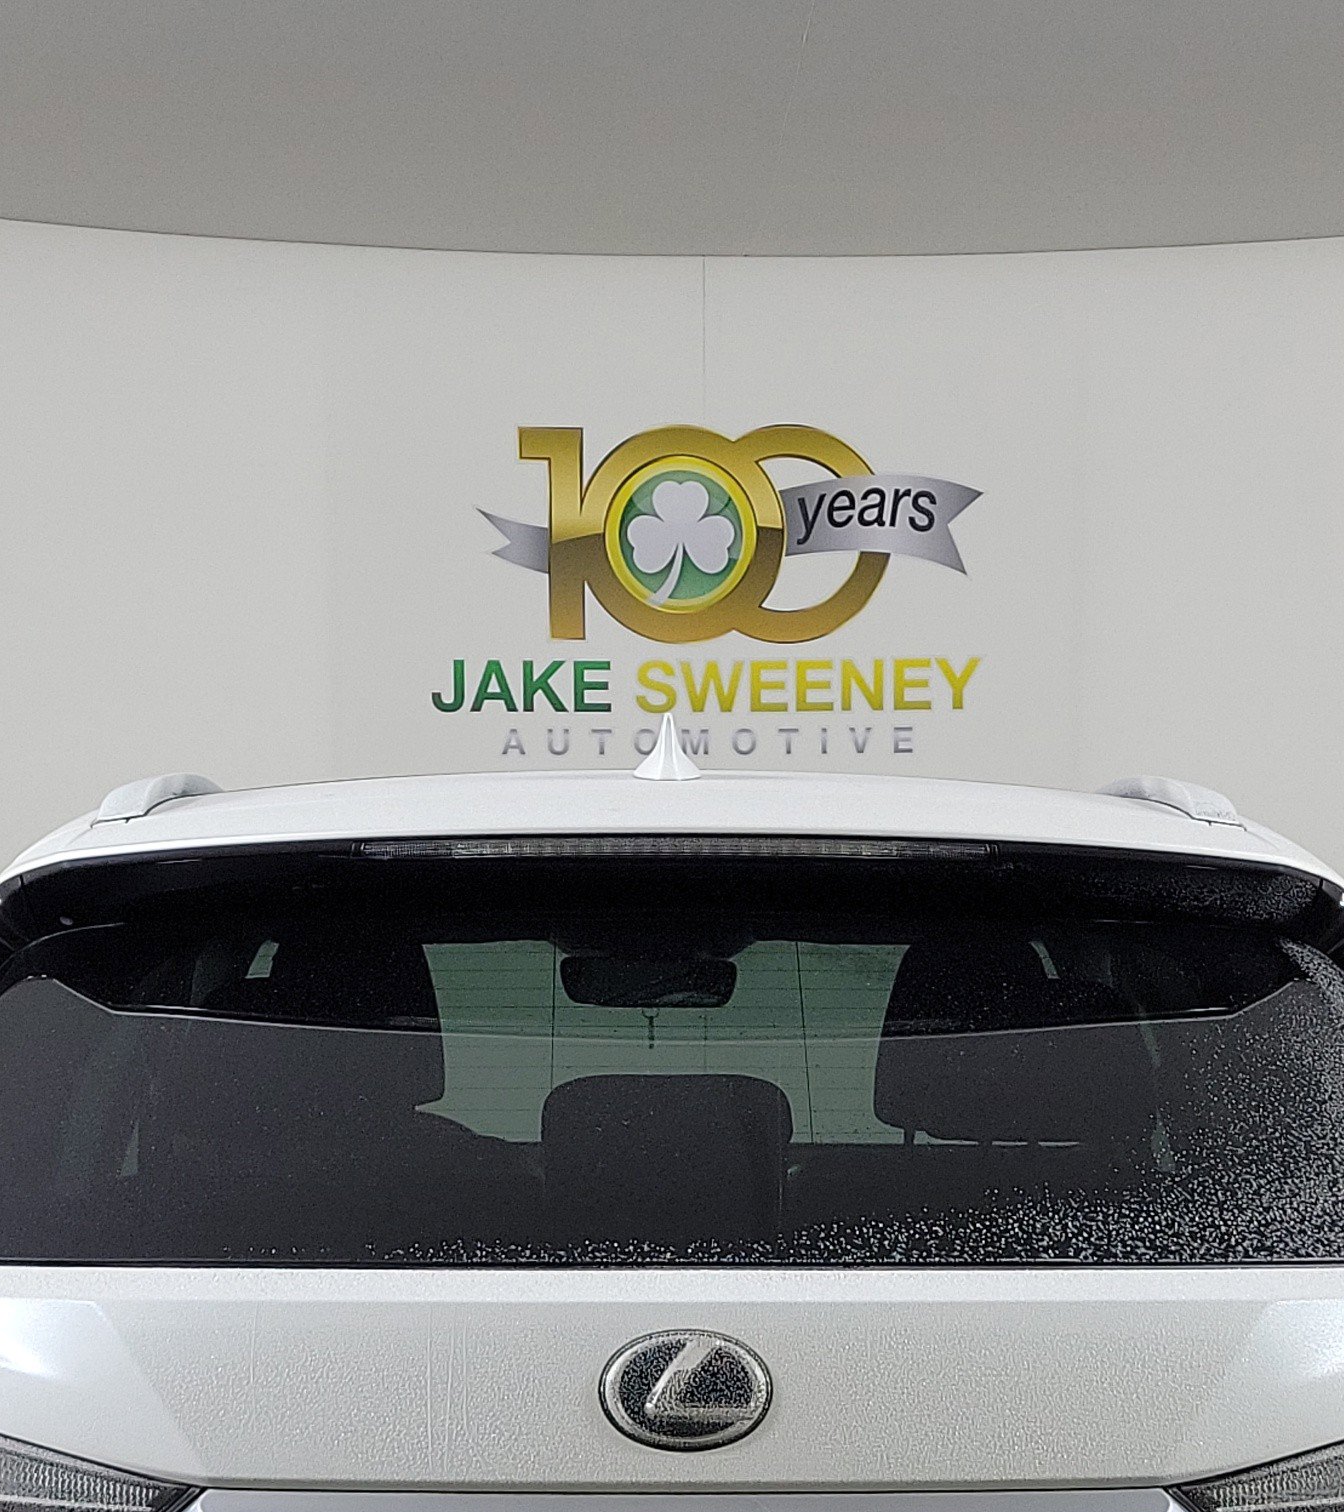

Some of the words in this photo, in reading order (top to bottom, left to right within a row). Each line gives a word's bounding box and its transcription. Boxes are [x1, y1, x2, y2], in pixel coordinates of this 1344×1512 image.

[517, 424, 892, 644] 100
[796, 486, 938, 545] years
[432, 659, 612, 713] JAKE
[635, 657, 982, 714] SWEENEY
[501, 726, 915, 756] AUTOMOTIVE
